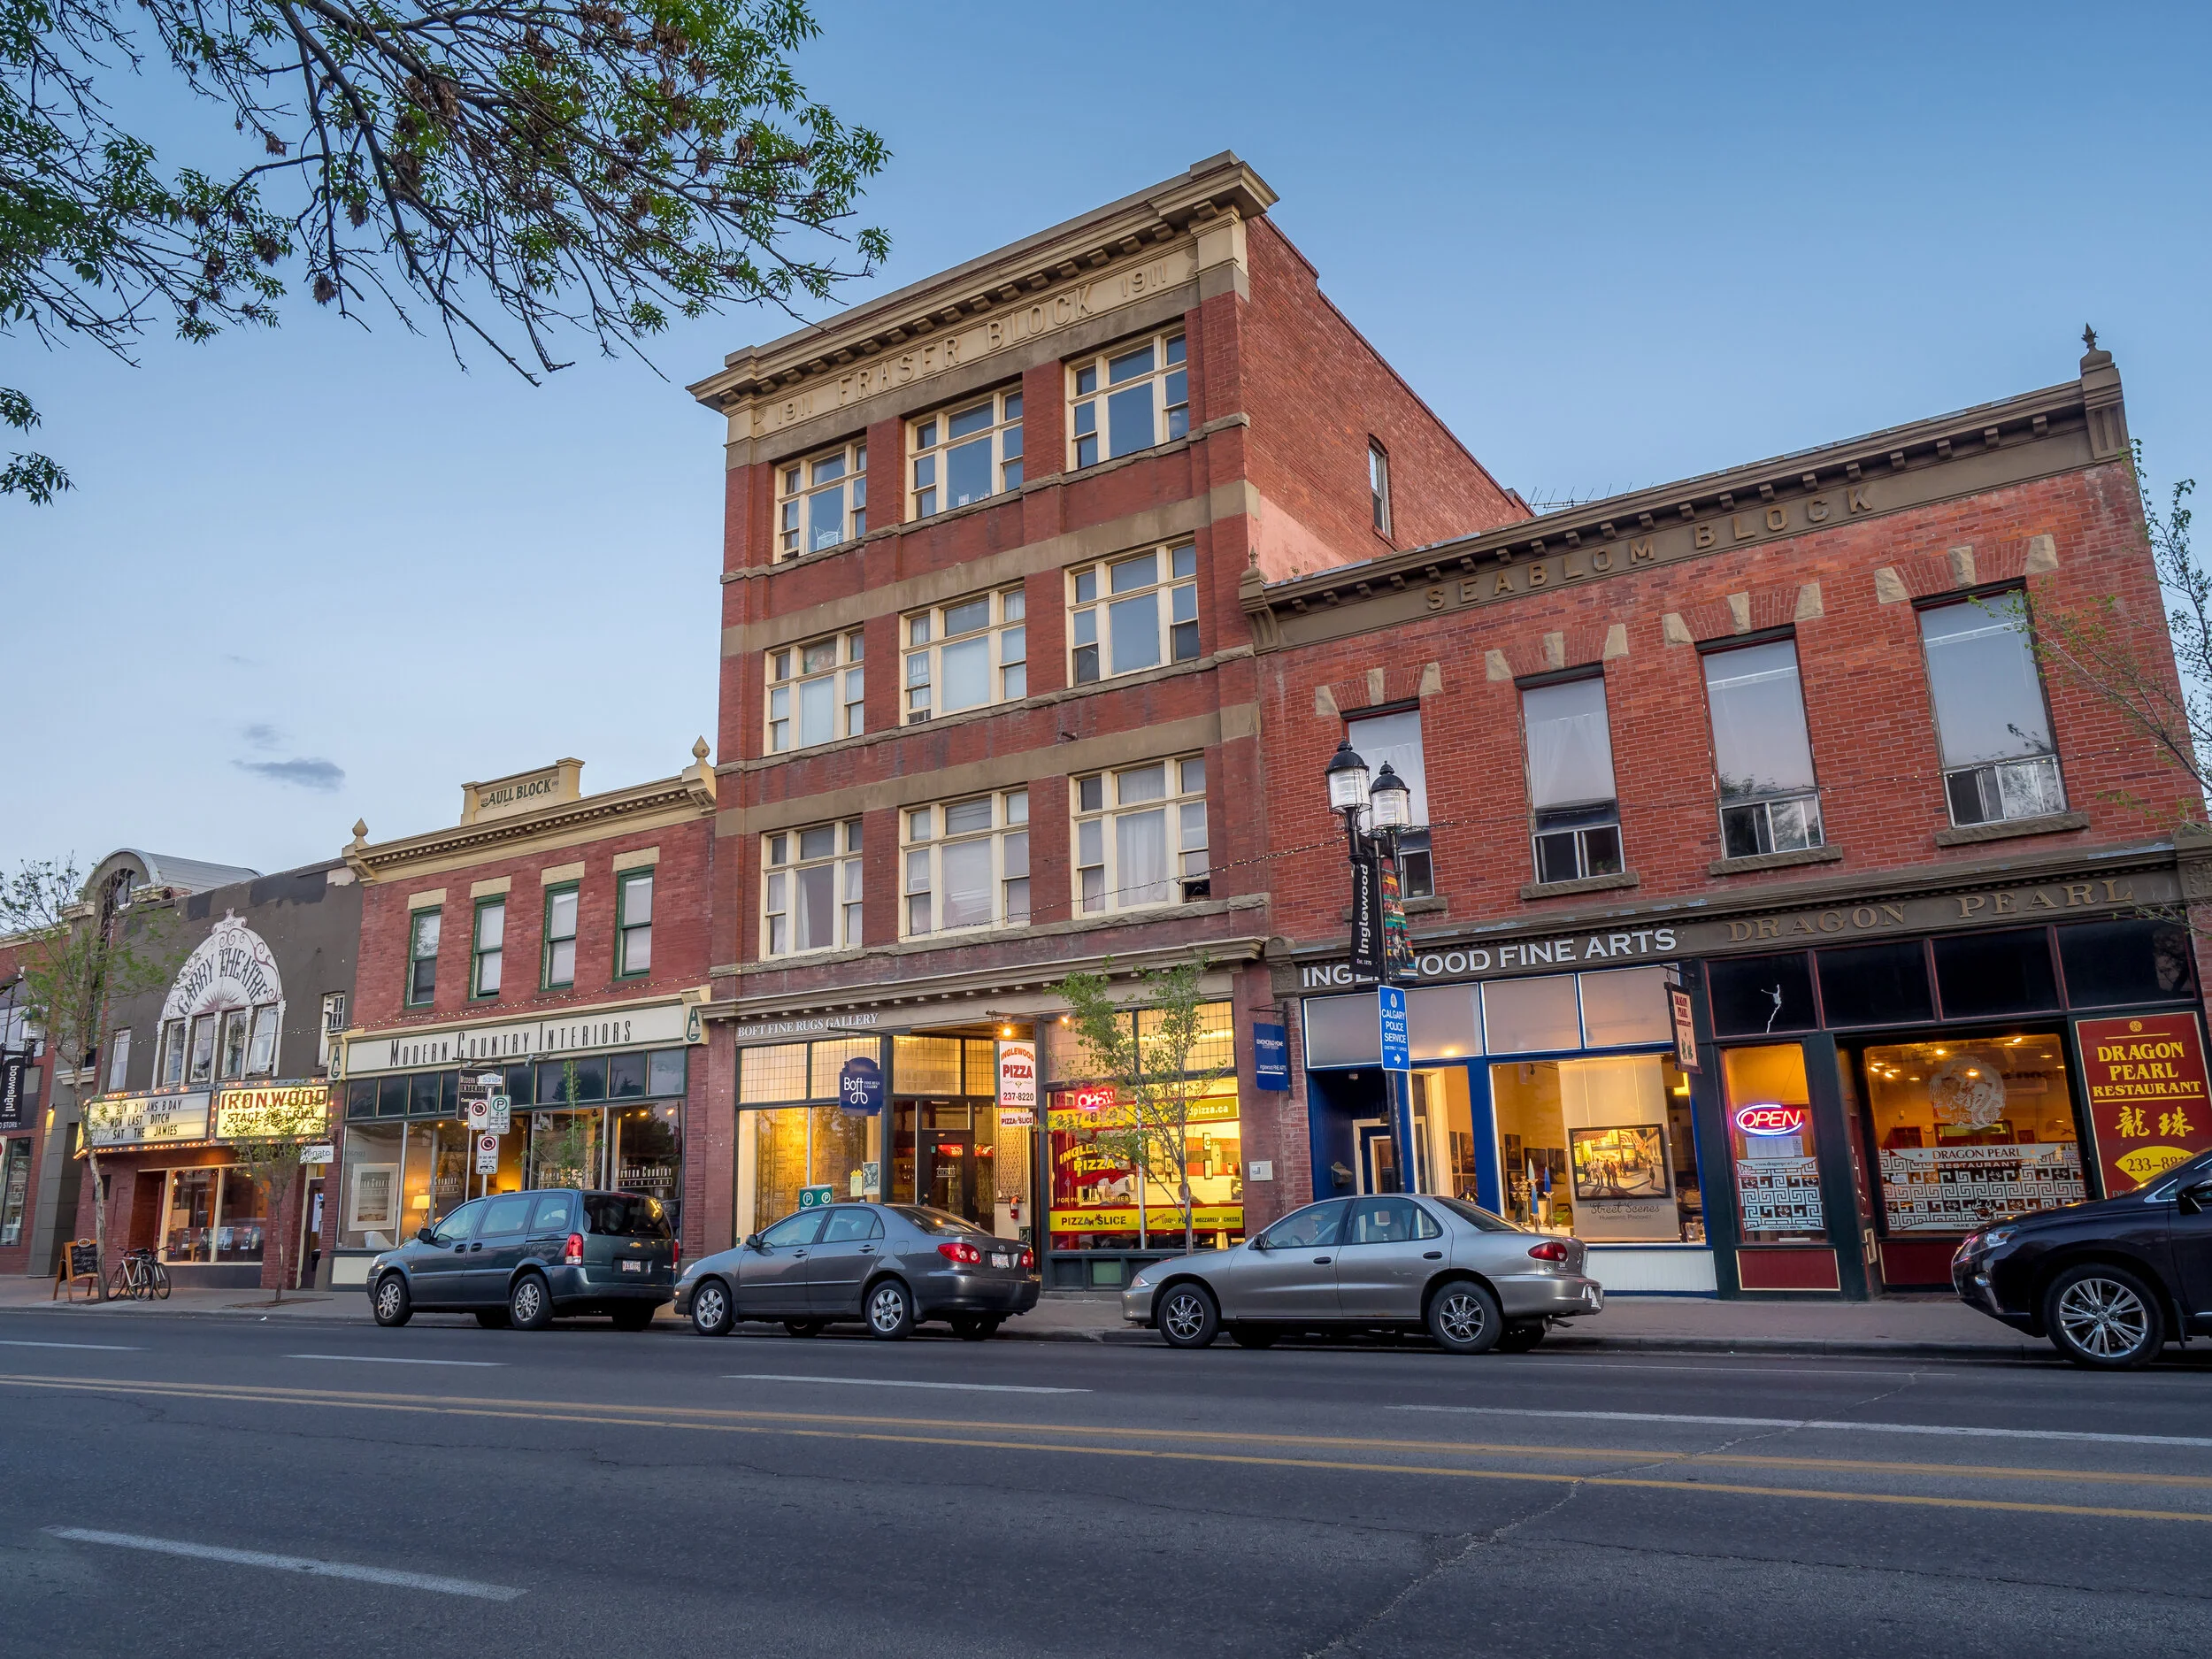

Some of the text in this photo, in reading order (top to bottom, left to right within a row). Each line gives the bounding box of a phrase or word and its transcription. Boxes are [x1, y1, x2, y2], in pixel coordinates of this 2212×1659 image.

[777, 262, 1168, 424] 1911 FRASER BLOCK 1911
[1427, 486, 1873, 611] SEABLOM BLOCK
[480, 779, 552, 807] AULL BLOCK
[1358, 864, 1371, 955] Inglewood
[1725, 879, 2133, 942] DRAGON PEARL
[1499, 939, 1577, 969] FINE
[1584, 928, 1678, 960] ARTS
[177, 948, 268, 1015] GARRY THEATRE
[1381, 1009, 1406, 1020] CALGARY
[737, 1012, 879, 1038] BOFT FINE RUGS GALLERY
[1386, 1021, 1404, 1032] POLICE
[389, 1020, 631, 1066] MODERN COUNTRY INTERIORS
[1384, 1033, 1407, 1044] SERVICE
[1001, 1048, 1034, 1063] INGLEWOOD
[2097, 1042, 2185, 1062] DRAGON
[1002, 1064, 1033, 1079] PIZZA
[2108, 1062, 2179, 1081] PEARL
[2093, 1081, 2201, 1097] RESTAURANT
[221, 1090, 327, 1110] IRONWOOD
[1003, 1092, 1034, 1102] 237-8220
[134, 1101, 158, 1113] DYLANS
[127, 1116, 143, 1126] LAST
[150, 1113, 170, 1124] DITCH
[227, 1112, 261, 1123] STAGE
[1740, 1110, 1801, 1127] OPEN
[113, 1125, 177, 1140] SAT THE JAMIES
[1932, 1148, 2023, 1160] DRAGON PEARL
[642, 1166, 672, 1177] COUNTRY
[1073, 1158, 1117, 1171] PIZZA
[1589, 1202, 1660, 1214] Street Scenes
[1061, 1217, 1089, 1226] PIZZA
[1097, 1216, 1126, 1225] SLICE
